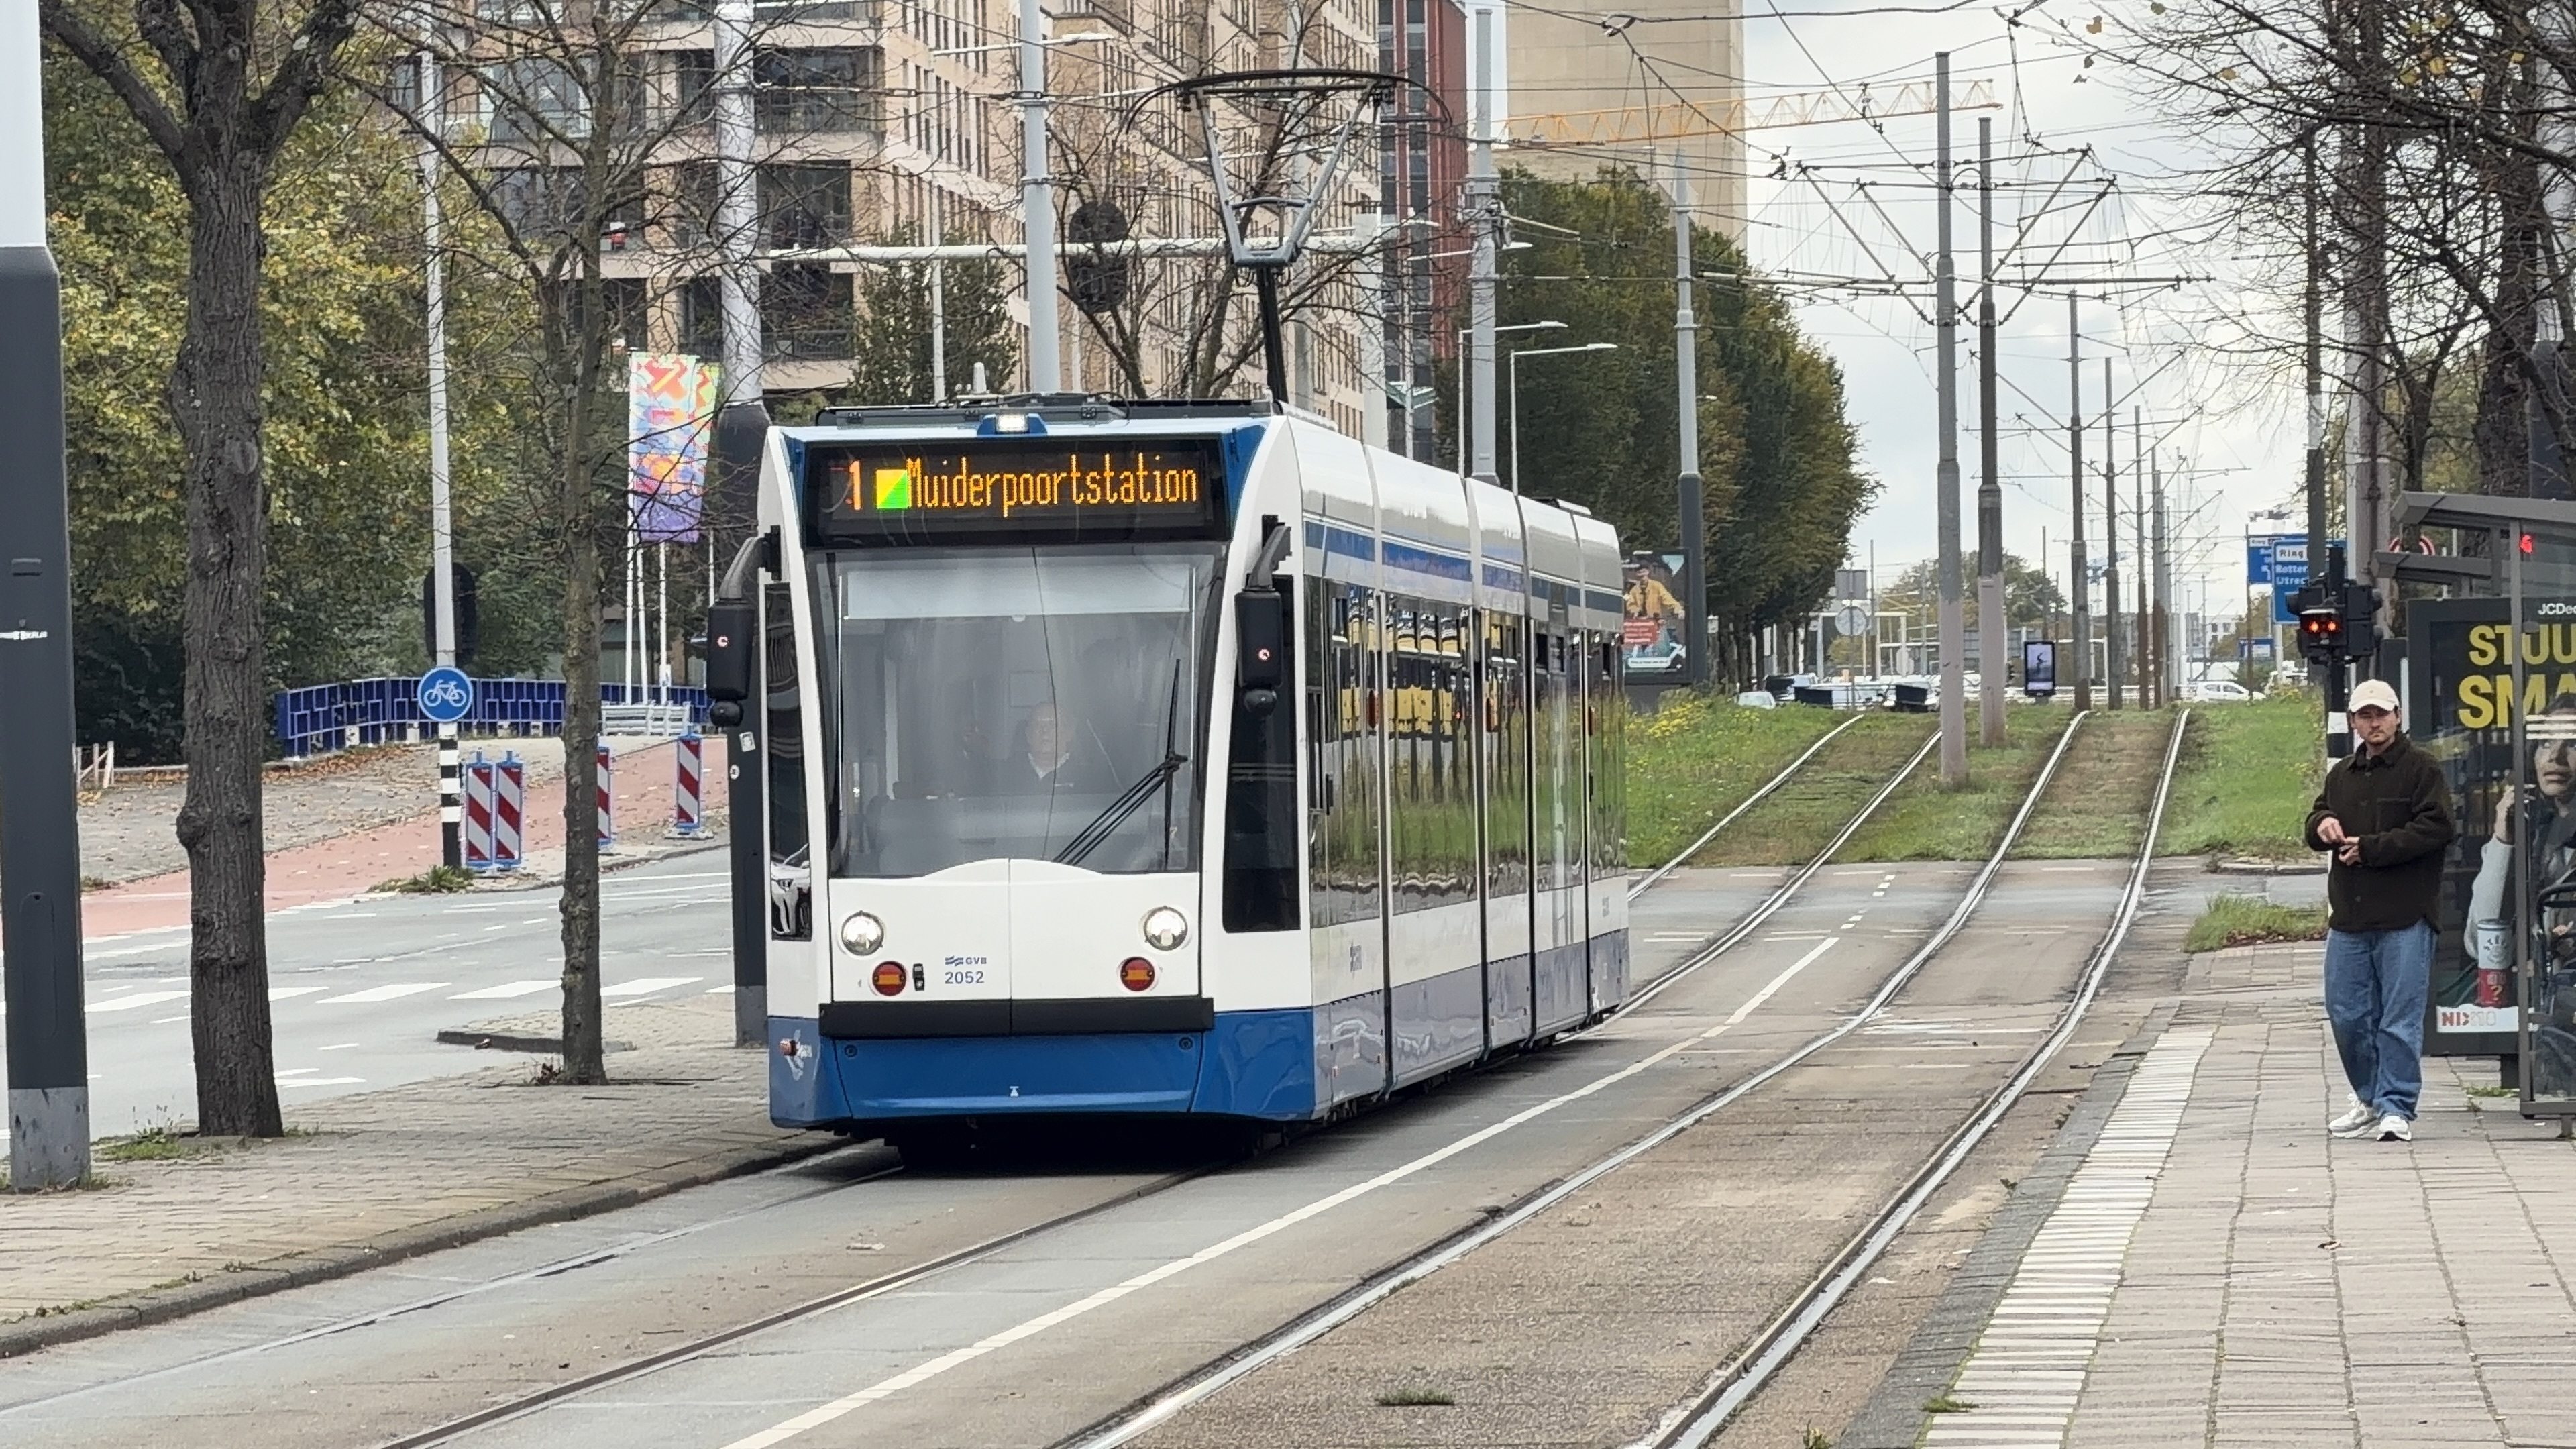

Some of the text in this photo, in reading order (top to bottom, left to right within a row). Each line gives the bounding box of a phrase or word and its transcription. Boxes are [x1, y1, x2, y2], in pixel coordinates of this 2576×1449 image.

[907, 452, 1197, 517] Muiderpoortstation
[2279, 549, 2304, 559] Ring
[945, 971, 984, 984] 2052
